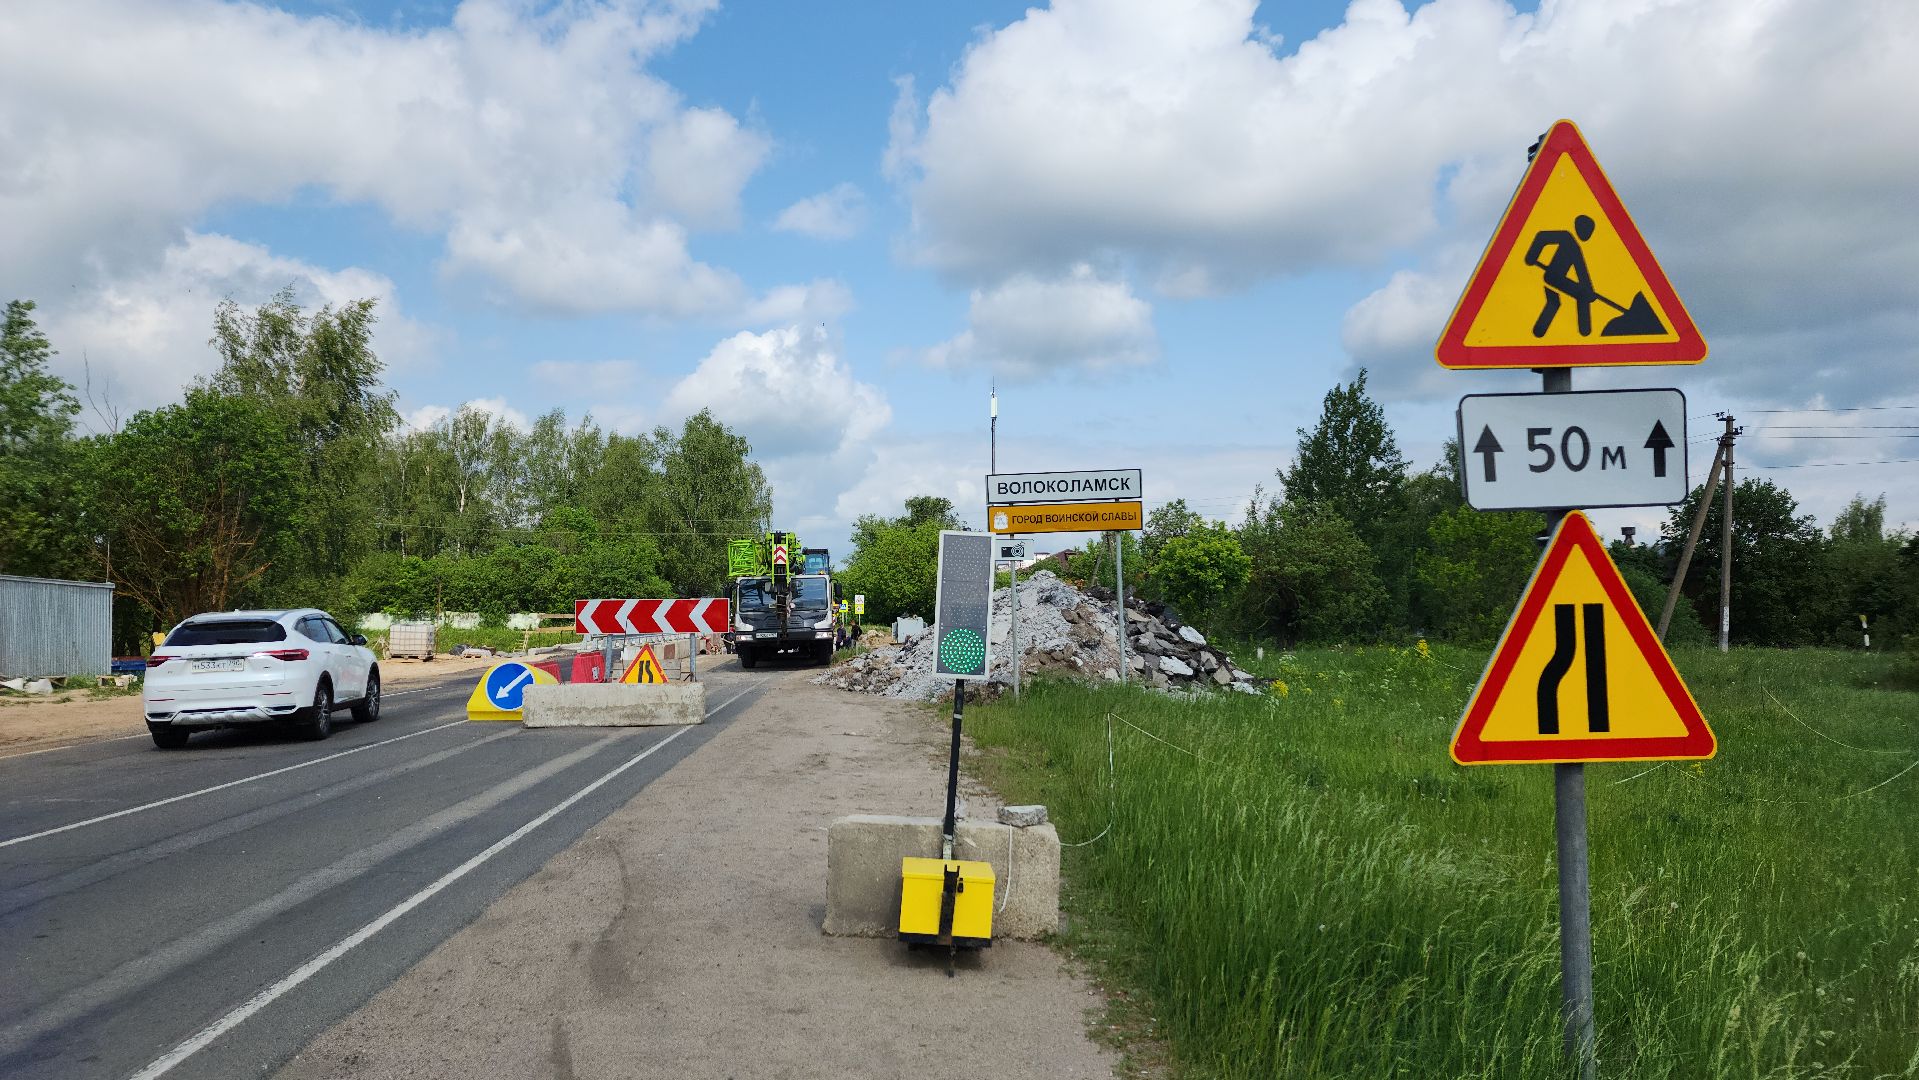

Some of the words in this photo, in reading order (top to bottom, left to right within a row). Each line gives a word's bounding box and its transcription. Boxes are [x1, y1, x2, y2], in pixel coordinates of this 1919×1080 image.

[1526, 425, 1591, 473] 50
[997, 477, 1131, 495] ВОЛОКОЛАМСК
[1012, 514, 1043, 525] ГОРОД
[1045, 511, 1099, 523] ВОИНСКОЙ
[1101, 511, 1137, 522] СЛАВЫ
